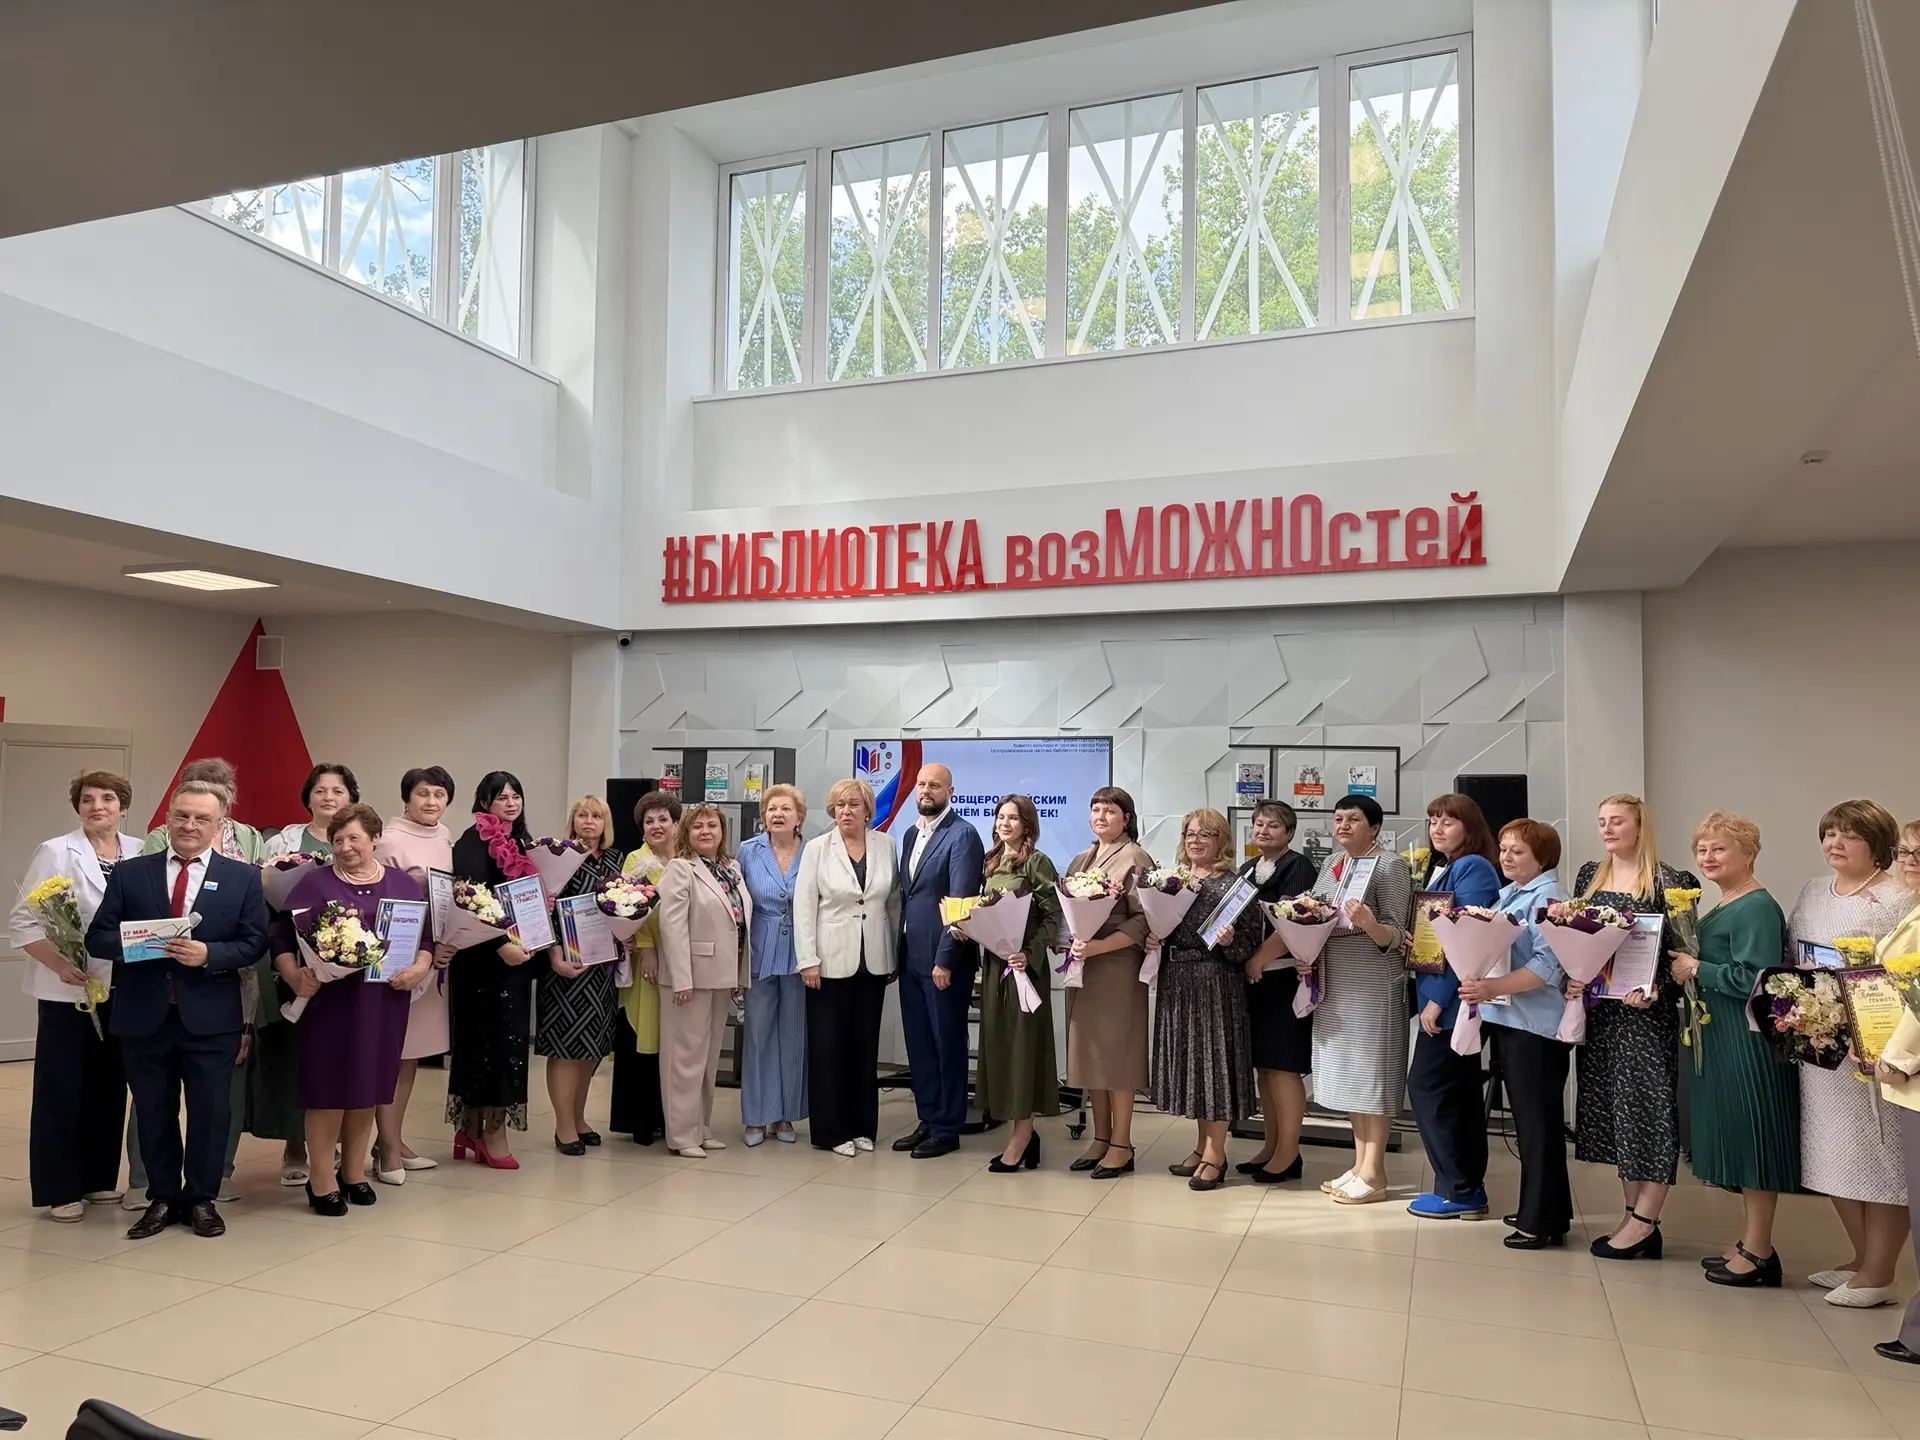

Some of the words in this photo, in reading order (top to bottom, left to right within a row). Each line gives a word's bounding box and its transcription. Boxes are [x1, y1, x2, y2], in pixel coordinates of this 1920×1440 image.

[662, 518, 989, 603] #БИБЛИОТЕКА
[1006, 490, 1486, 587] возМОЖНОстей
[950, 793, 1067, 805] ОБЩЕРОСКИМ
[953, 806, 980, 817] НЁМ
